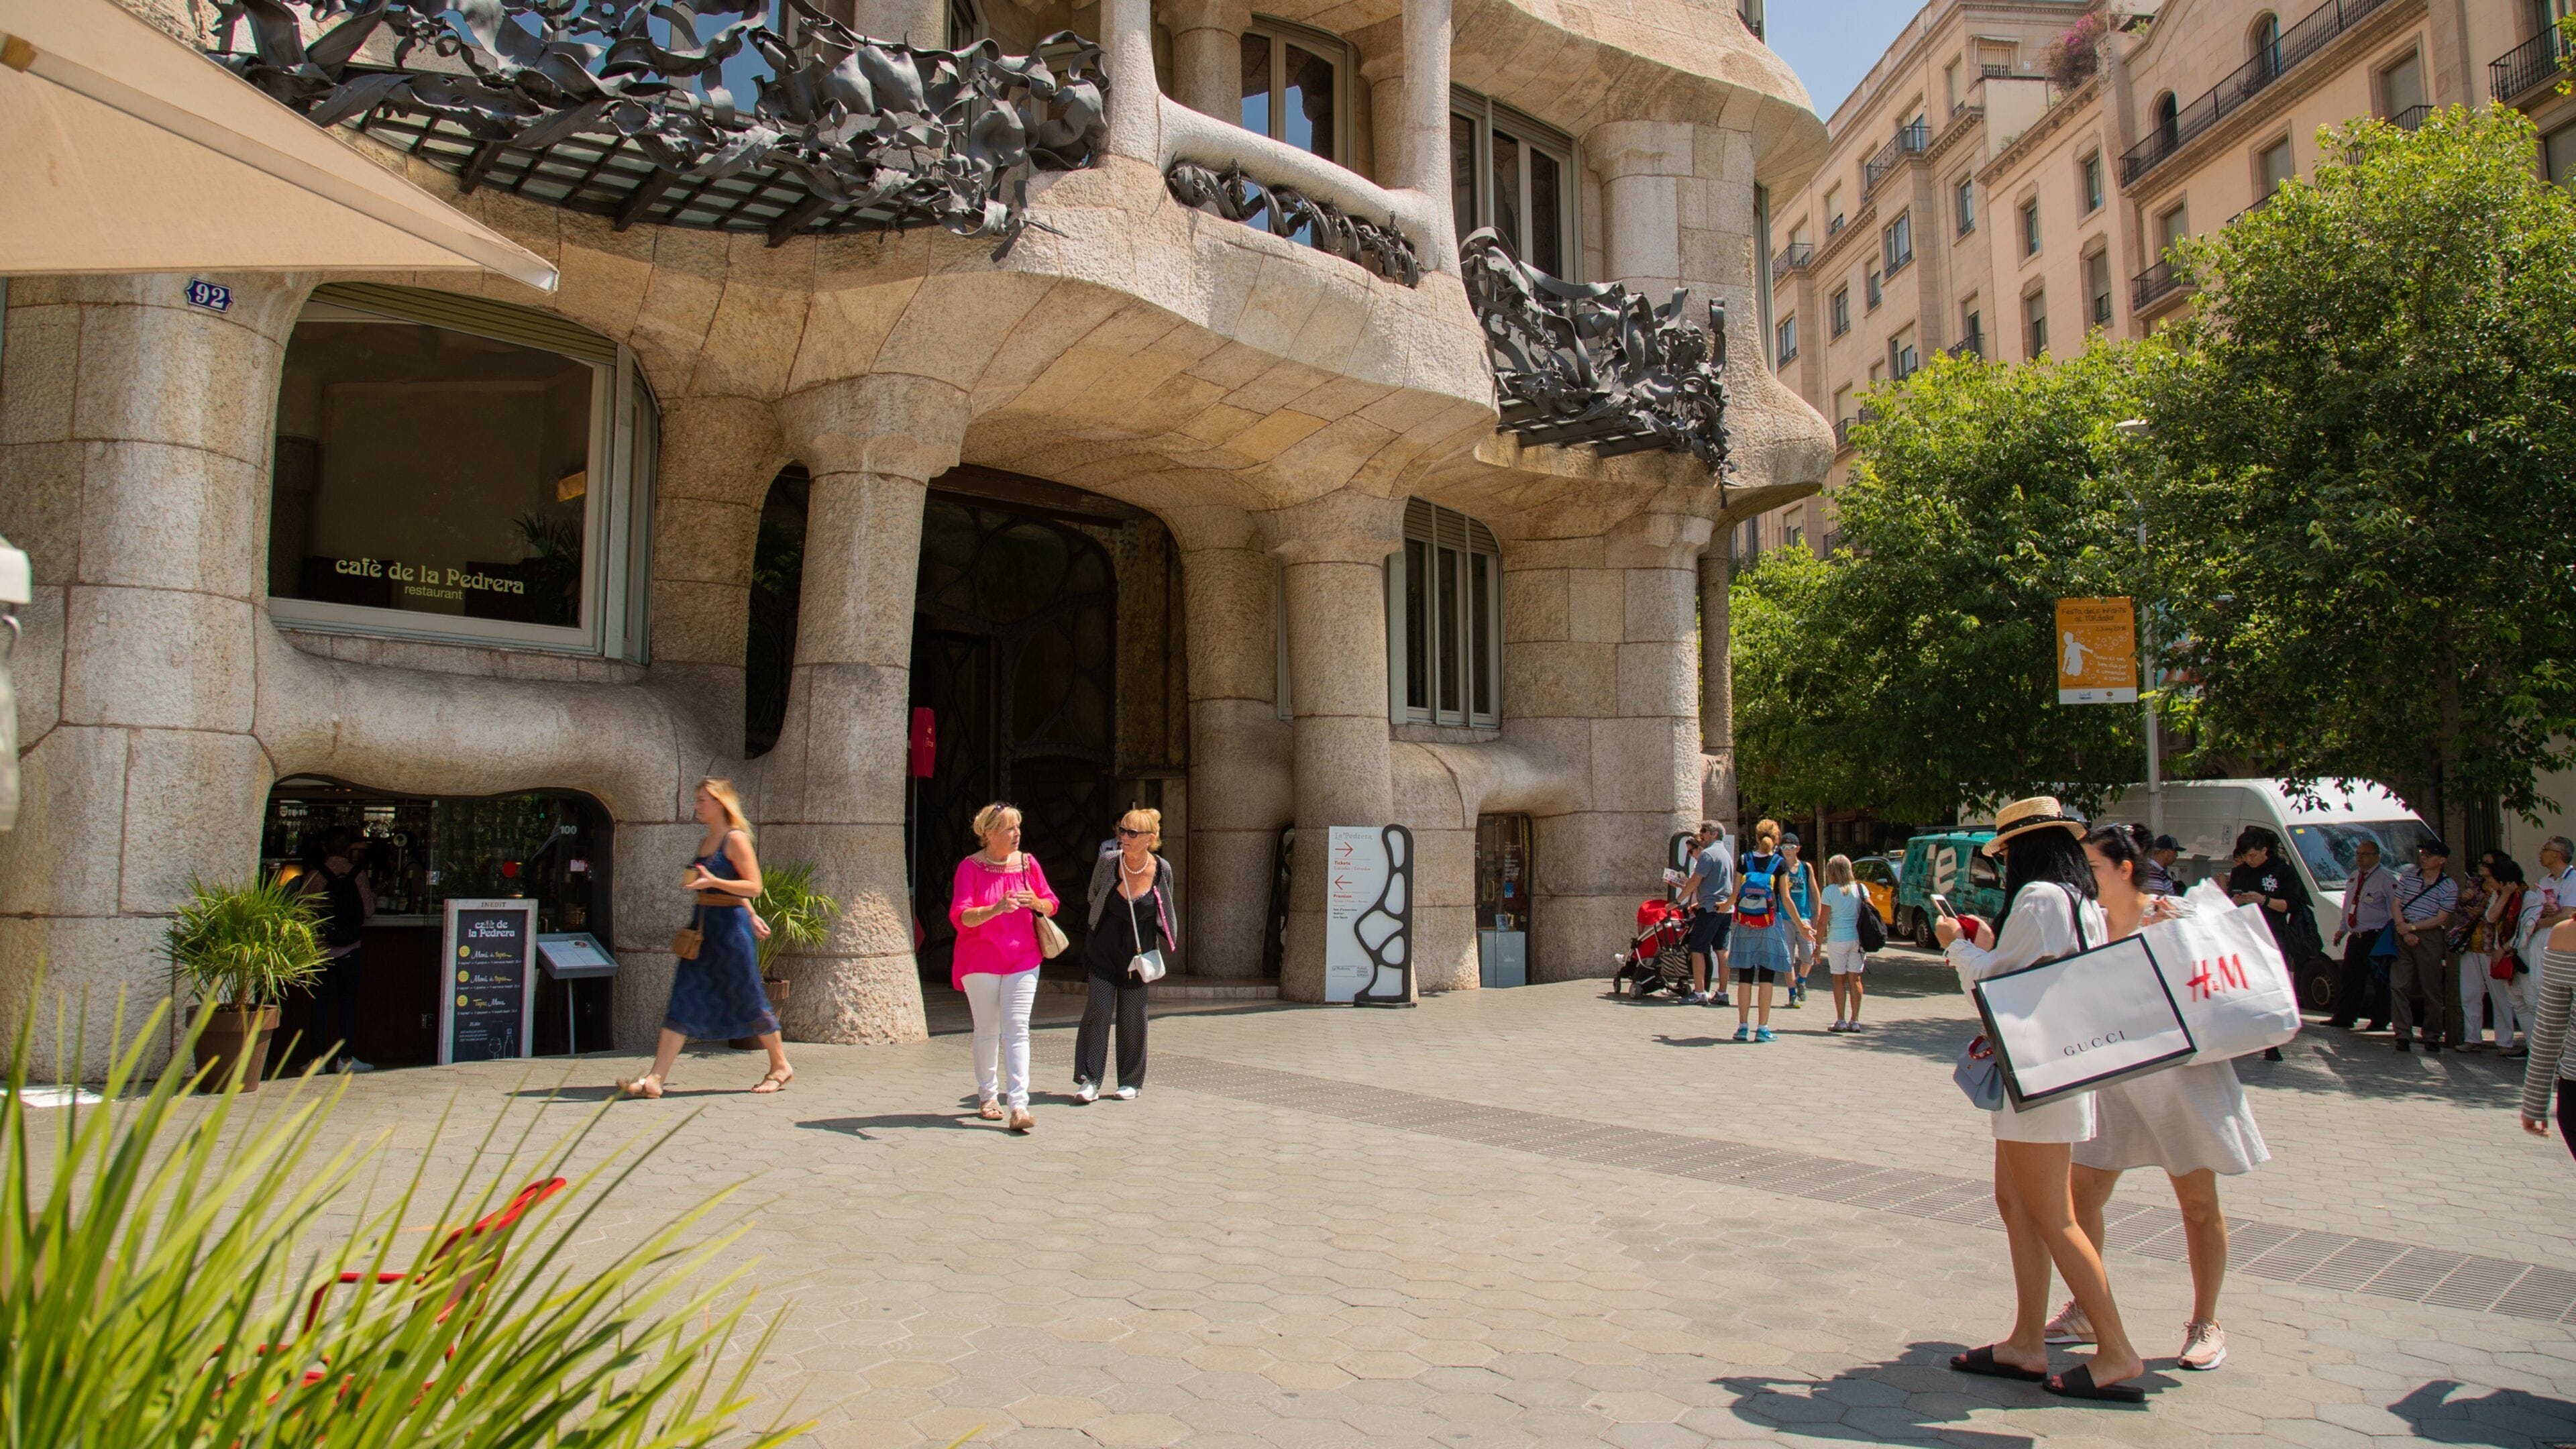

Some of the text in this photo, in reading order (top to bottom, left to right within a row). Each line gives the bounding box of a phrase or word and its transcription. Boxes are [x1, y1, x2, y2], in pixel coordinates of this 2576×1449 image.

[196, 284, 225, 309] 92
[335, 558, 525, 594] cafè de la Pedrera
[405, 585, 463, 600] restaurant
[559, 825, 578, 835] 100
[1343, 832, 1373, 840] Pedrera
[496, 920, 508, 929] de
[468, 928, 516, 938] la Pedrera
[2185, 953, 2250, 1003] H&M
[2063, 1030, 2127, 1057] GUCCI
